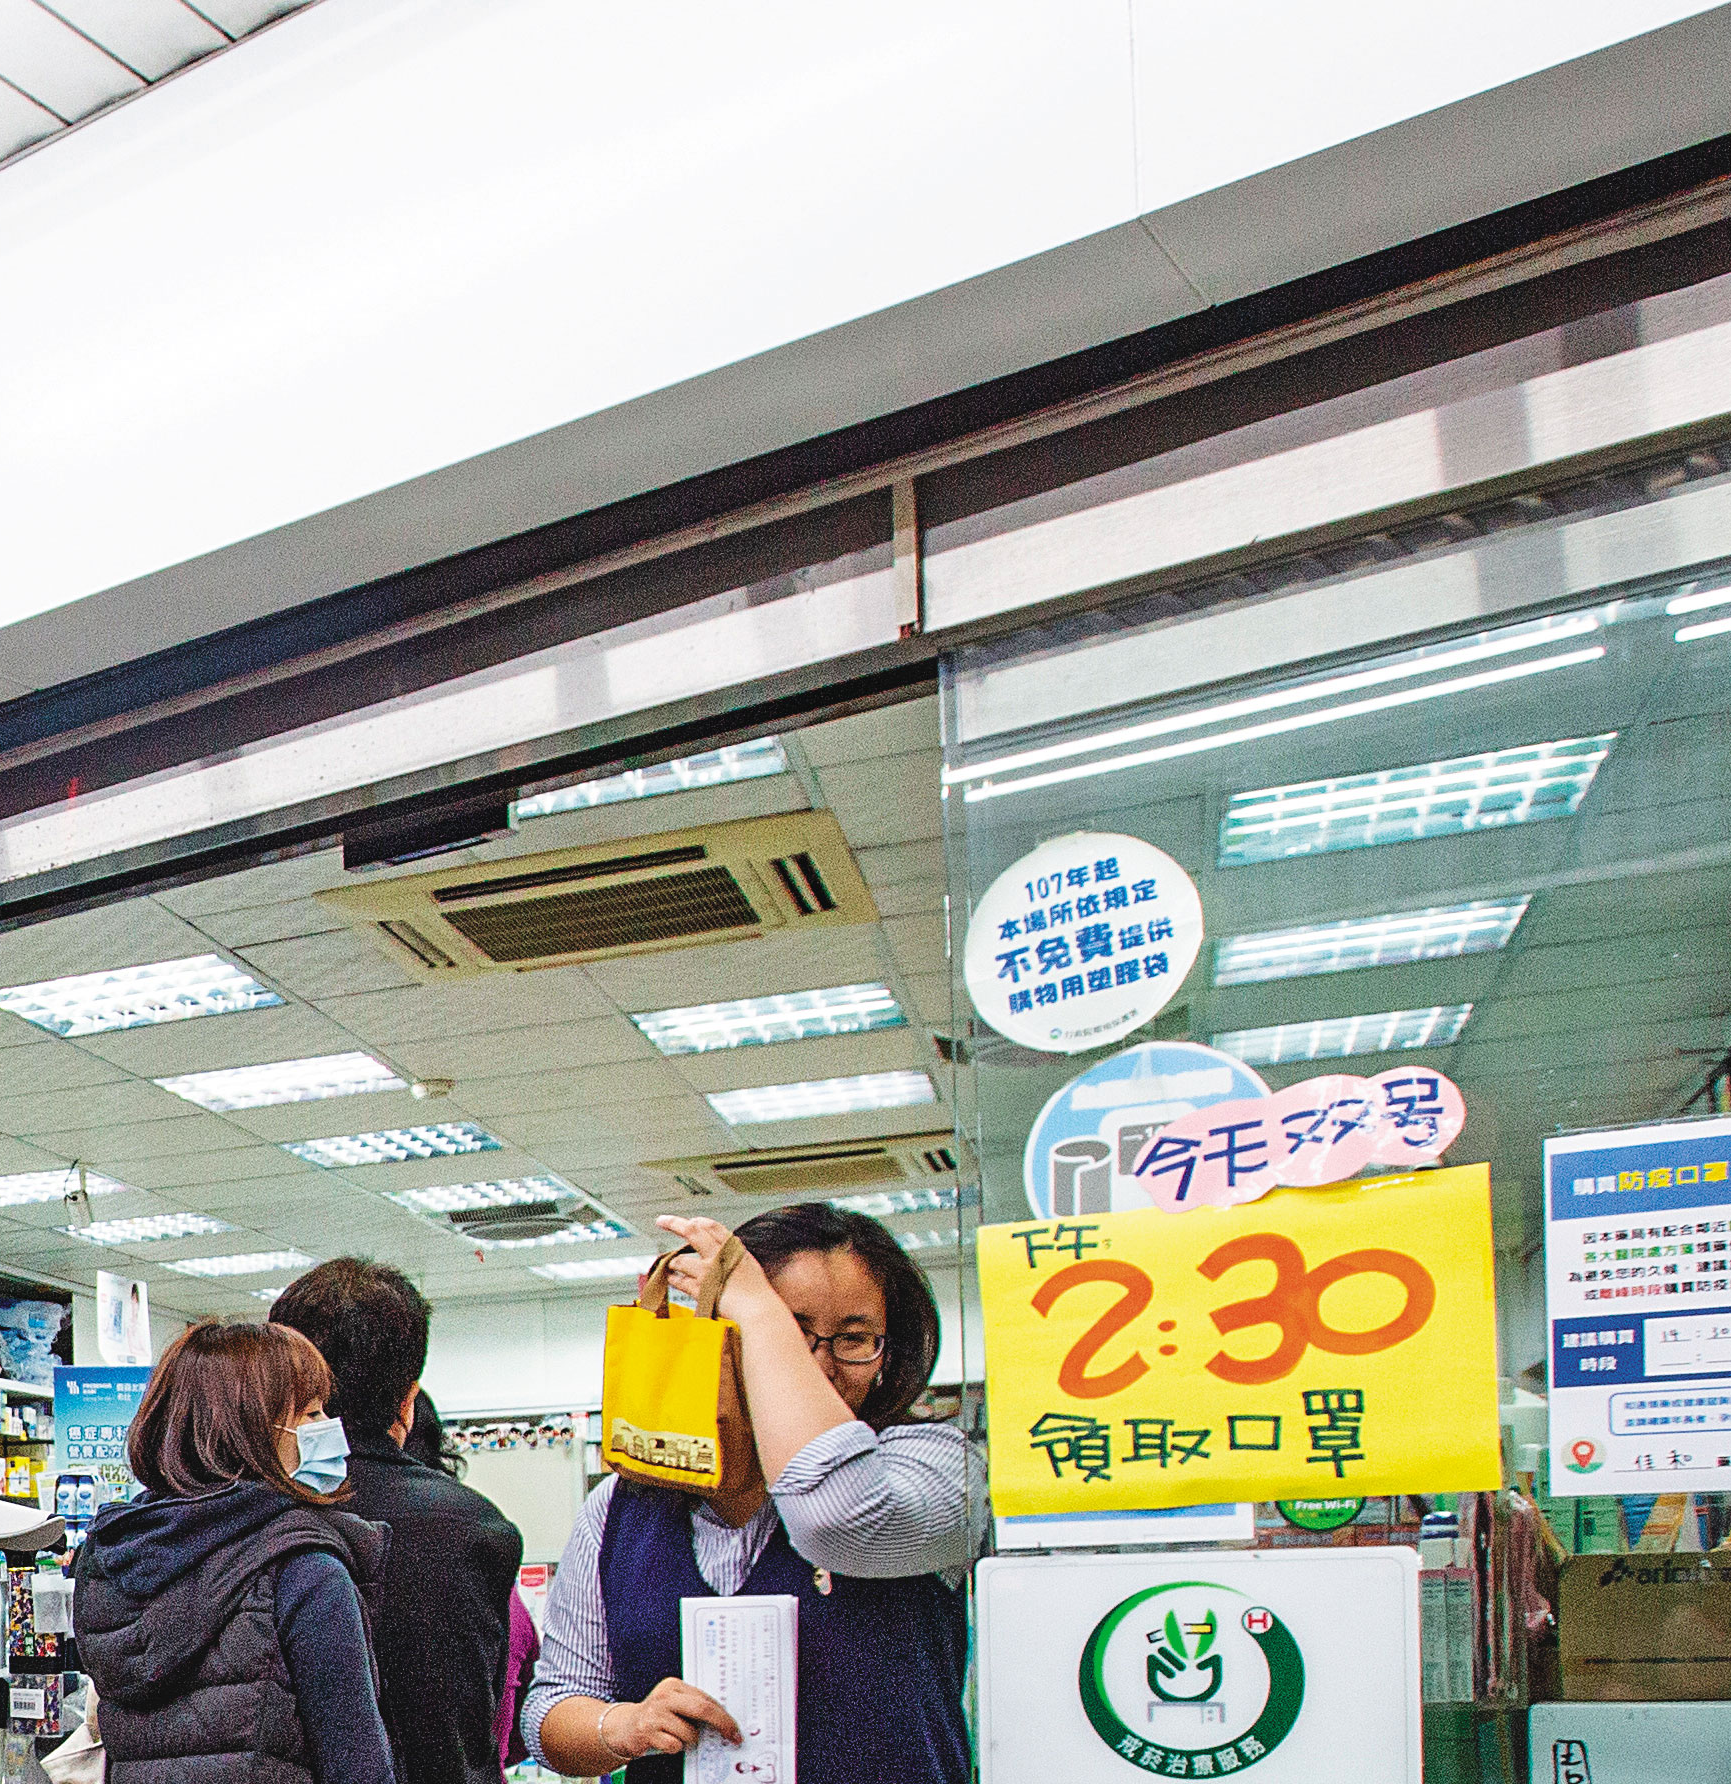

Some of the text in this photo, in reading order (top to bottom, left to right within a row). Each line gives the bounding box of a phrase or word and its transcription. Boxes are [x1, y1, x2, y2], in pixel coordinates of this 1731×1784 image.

[997, 878, 1159, 941] 本場所依規定
[1025, 856, 1121, 902] 107年起
[1008, 952, 1170, 1015] 購物用塑膠袋
[1031, 1232, 1435, 1400] 2:30
[1030, 1389, 1366, 1482] 領取口罩
[1117, 1733, 1268, 1778] 戒菸治療服務
